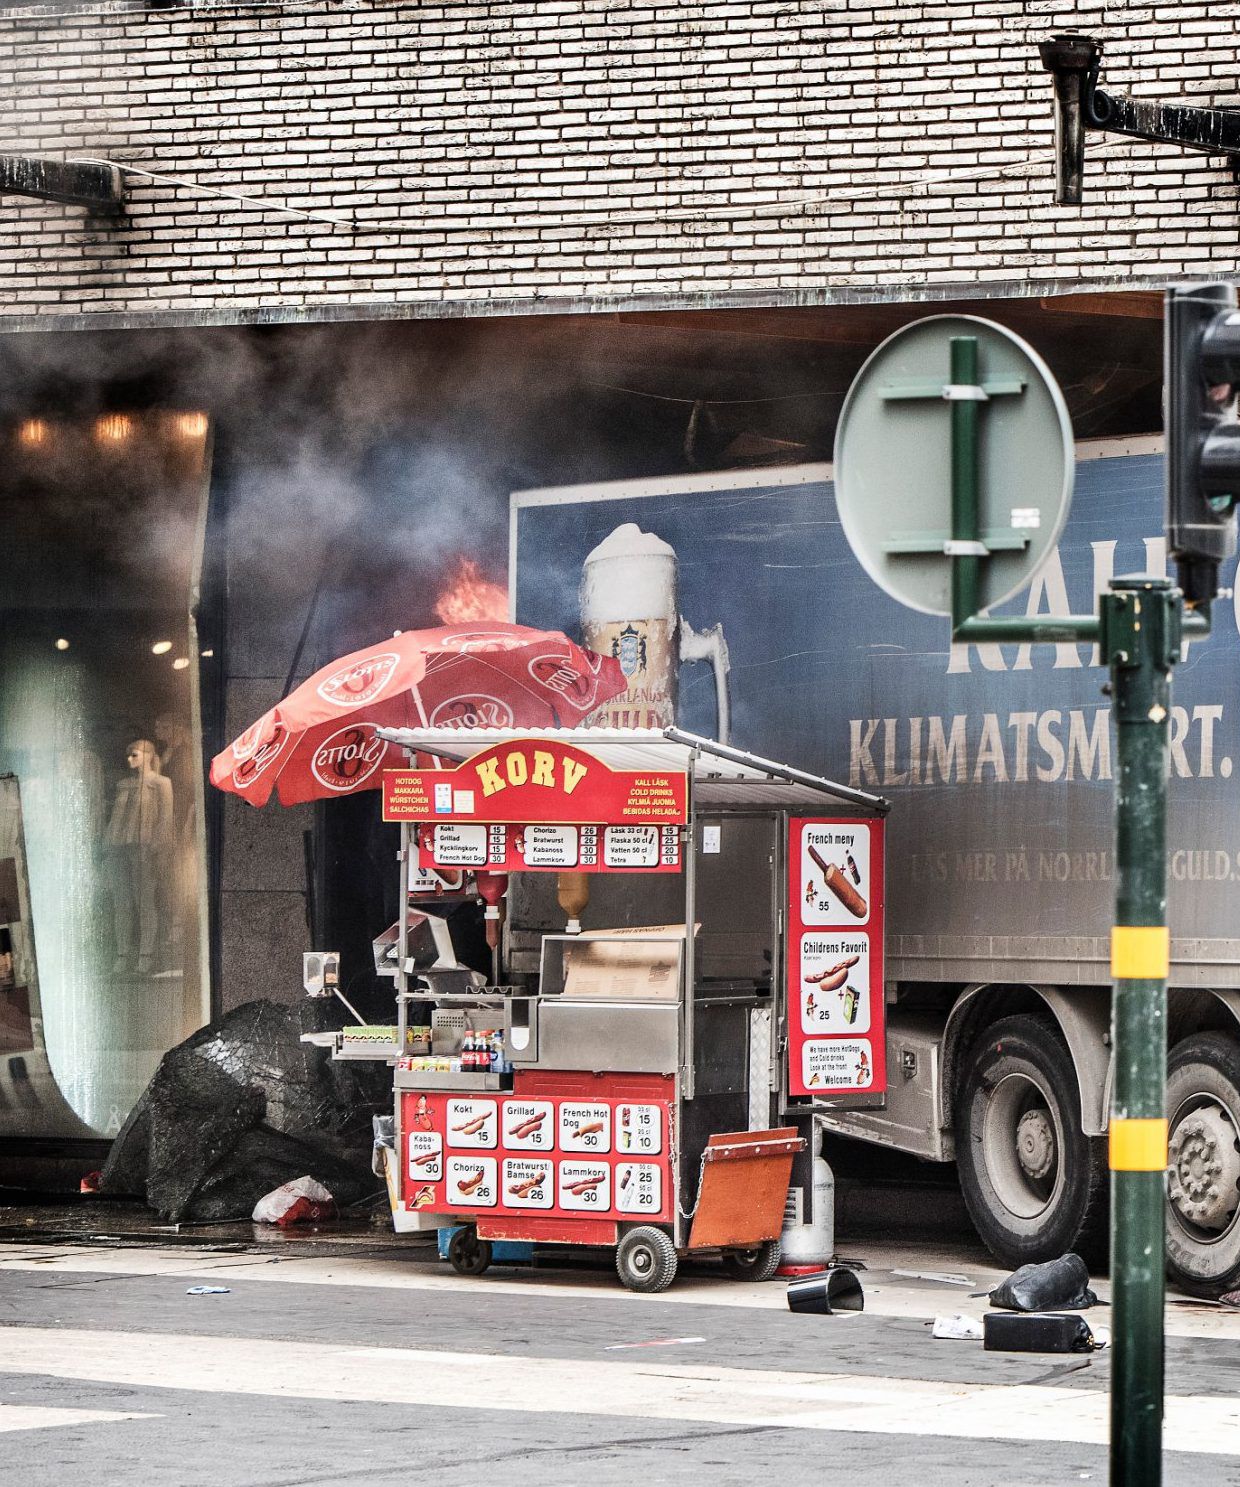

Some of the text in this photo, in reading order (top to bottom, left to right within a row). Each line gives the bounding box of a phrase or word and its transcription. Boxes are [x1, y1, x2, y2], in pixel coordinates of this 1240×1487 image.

[850, 704, 1233, 787] KLIMATSMRT.
[476, 750, 588, 798] KORV
[395, 777, 423, 786] HOTDOG
[635, 779, 651, 787] KALL
[394, 786, 424, 795] MAKKARA
[631, 788, 649, 796] COLD
[389, 795, 429, 805] WÜRSTCHEN
[652, 798, 676, 806] JUOMIA
[389, 805, 430, 814] SALCHICHAS
[623, 807, 651, 815] BEBIDAS
[493, 826, 502, 834] 15
[584, 827, 594, 835] 26
[666, 827, 674, 835] 15
[808, 832, 855, 847] French meny
[440, 845, 479, 853] Kycklingkorv
[665, 846, 674, 854] 20
[474, 855, 487, 863] Dog
[957, 852, 997, 881] MER
[818, 901, 830, 911] 55
[804, 942, 867, 953] Childrens Favorit
[819, 1010, 830, 1020] 25
[825, 1075, 852, 1084] Welcome
[453, 1105, 474, 1113] Kokt
[507, 1106, 535, 1116] Grillad
[563, 1108, 609, 1119] French Hot
[563, 1119, 580, 1129] Dog
[639, 1114, 651, 1124] 15
[414, 1135, 435, 1143] Kaba-
[478, 1131, 489, 1142] 15
[531, 1132, 542, 1144] 15
[584, 1136, 598, 1146] 30
[640, 1137, 651, 1148] 10
[426, 1163, 439, 1174] 30
[453, 1163, 485, 1172] Chorizo
[563, 1168, 606, 1177] Lammkorv
[507, 1171, 535, 1180] Bamse
[639, 1172, 652, 1183] 25
[477, 1187, 490, 1197] 26
[530, 1190, 543, 1200] 26
[583, 1193, 597, 1204] 30
[640, 1194, 652, 1205] 20
